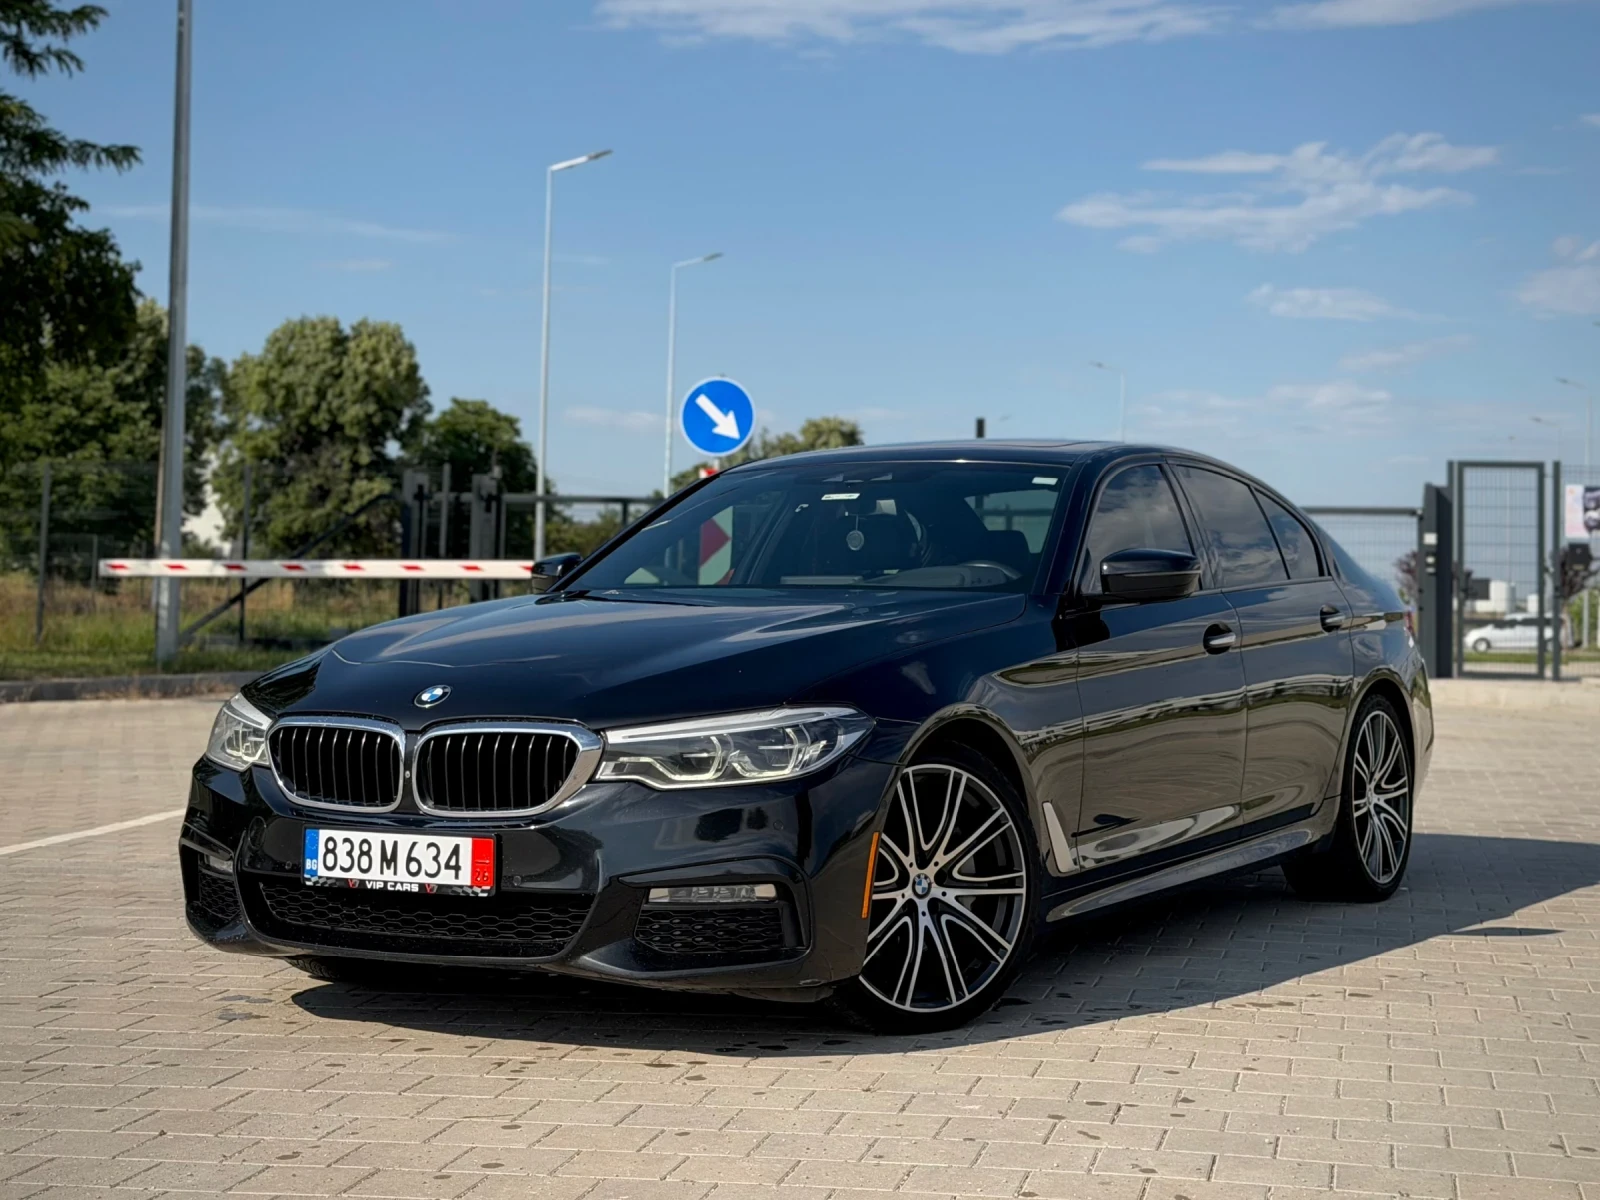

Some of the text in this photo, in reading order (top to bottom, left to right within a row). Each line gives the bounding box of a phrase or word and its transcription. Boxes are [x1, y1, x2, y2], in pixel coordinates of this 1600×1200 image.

[305, 836, 462, 880] BG 838 M 634
[365, 880, 419, 892] VIP CARS
